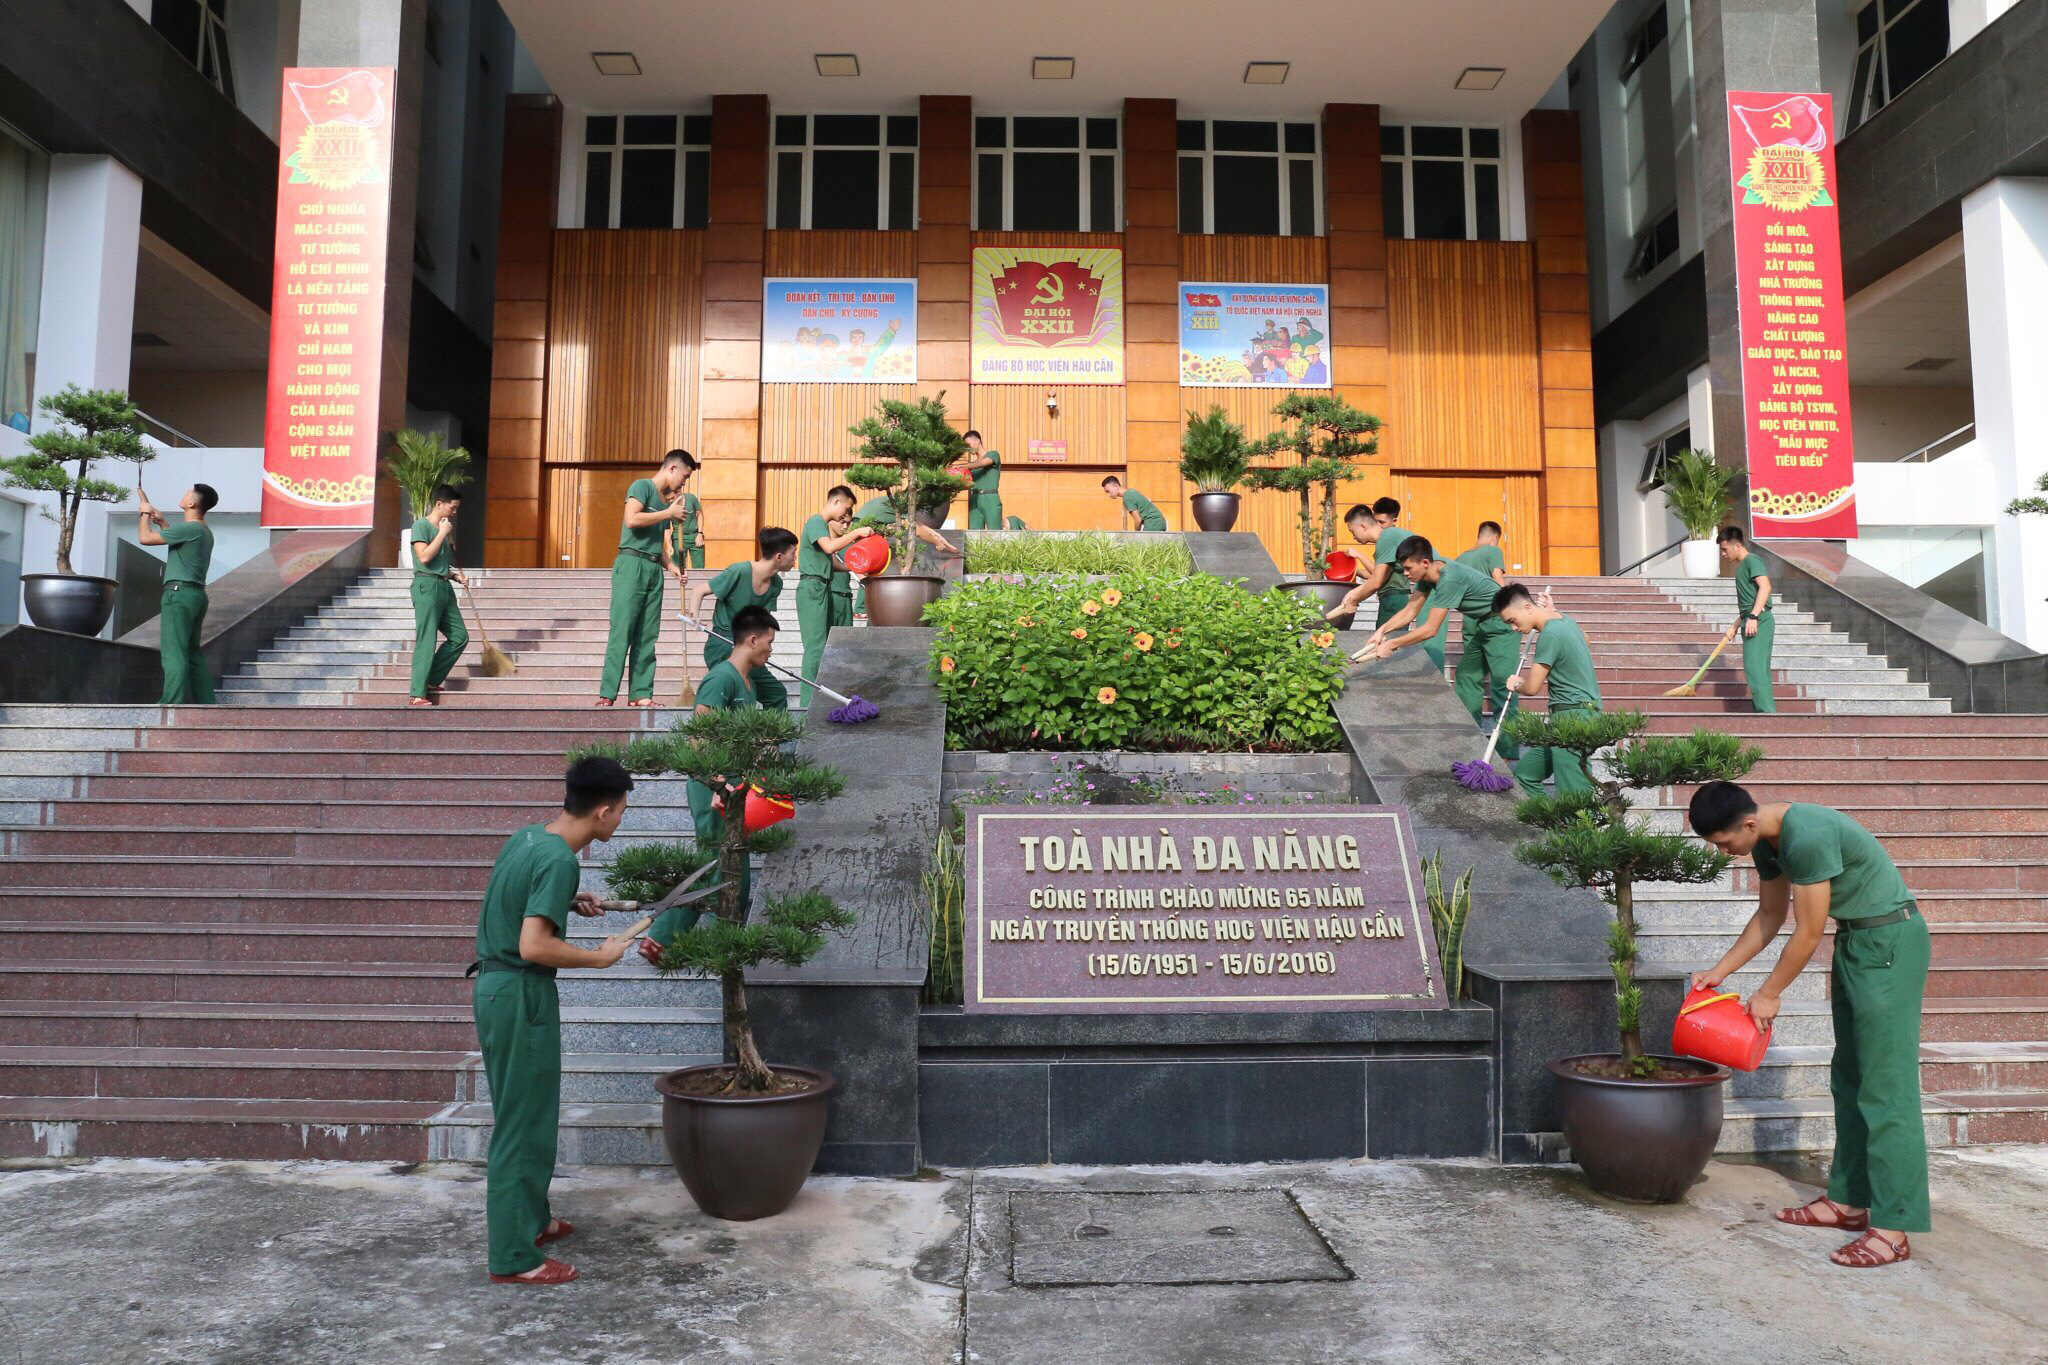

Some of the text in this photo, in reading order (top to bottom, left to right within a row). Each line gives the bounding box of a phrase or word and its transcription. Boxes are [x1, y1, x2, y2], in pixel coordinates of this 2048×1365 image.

[313, 140, 360, 155] XXII
[1762, 161, 1807, 179] XXII
[1766, 221, 1809, 238] ĐỔI MỚI,
[1764, 240, 1814, 256] SÁNG TẠO
[335, 263, 369, 275] MINH
[1765, 258, 1815, 273] XÂY DỰNG
[1759, 275, 1823, 289] NHÀ TRƯỜNG
[1759, 293, 1825, 308] THÔNG MINH,
[1024, 307, 1072, 319] ĐẠI HỘI
[1767, 311, 1818, 324] NÂNG CAO
[324, 323, 349, 335] KIM
[1020, 319, 1075, 334] XXII
[1192, 317, 1219, 330] XIII
[1763, 327, 1825, 344] CHẤT LƯỢNG
[322, 343, 353, 355] NAM
[1747, 346, 1842, 363] GIÁO DỤC, ĐÀO TẠO
[297, 364, 323, 376] CHO
[1772, 364, 1820, 379] VÀ NCKH,
[1772, 382, 1823, 397] XÂY DỰNG
[1759, 398, 1838, 415] ĐẢNG BỘ TSVM,
[1759, 419, 1780, 432] HỌC
[1783, 417, 1806, 432] VIỆN
[320, 445, 351, 457] NAM
[1805, 437, 1828, 451] MỰC
[1775, 453, 1797, 467] TIÊU
[1019, 828, 1361, 872] TOÀ NHÀ ĐA NĂNG
[1029, 883, 1365, 910] CÔNG TRÌNH CHÀO MỪNG 65 NĂM
[990, 916, 1048, 941] NGÀY
[1053, 912, 1136, 941] TRUYỀN
[1140, 911, 1209, 940] THỐNG
[1261, 915, 1310, 944] VIỆN
[1314, 913, 1357, 944] HẬU
[1360, 909, 1405, 938] CẦN
[1088, 952, 1198, 977] (15/6/1951
[1219, 950, 1336, 975] 15/6/2016)
